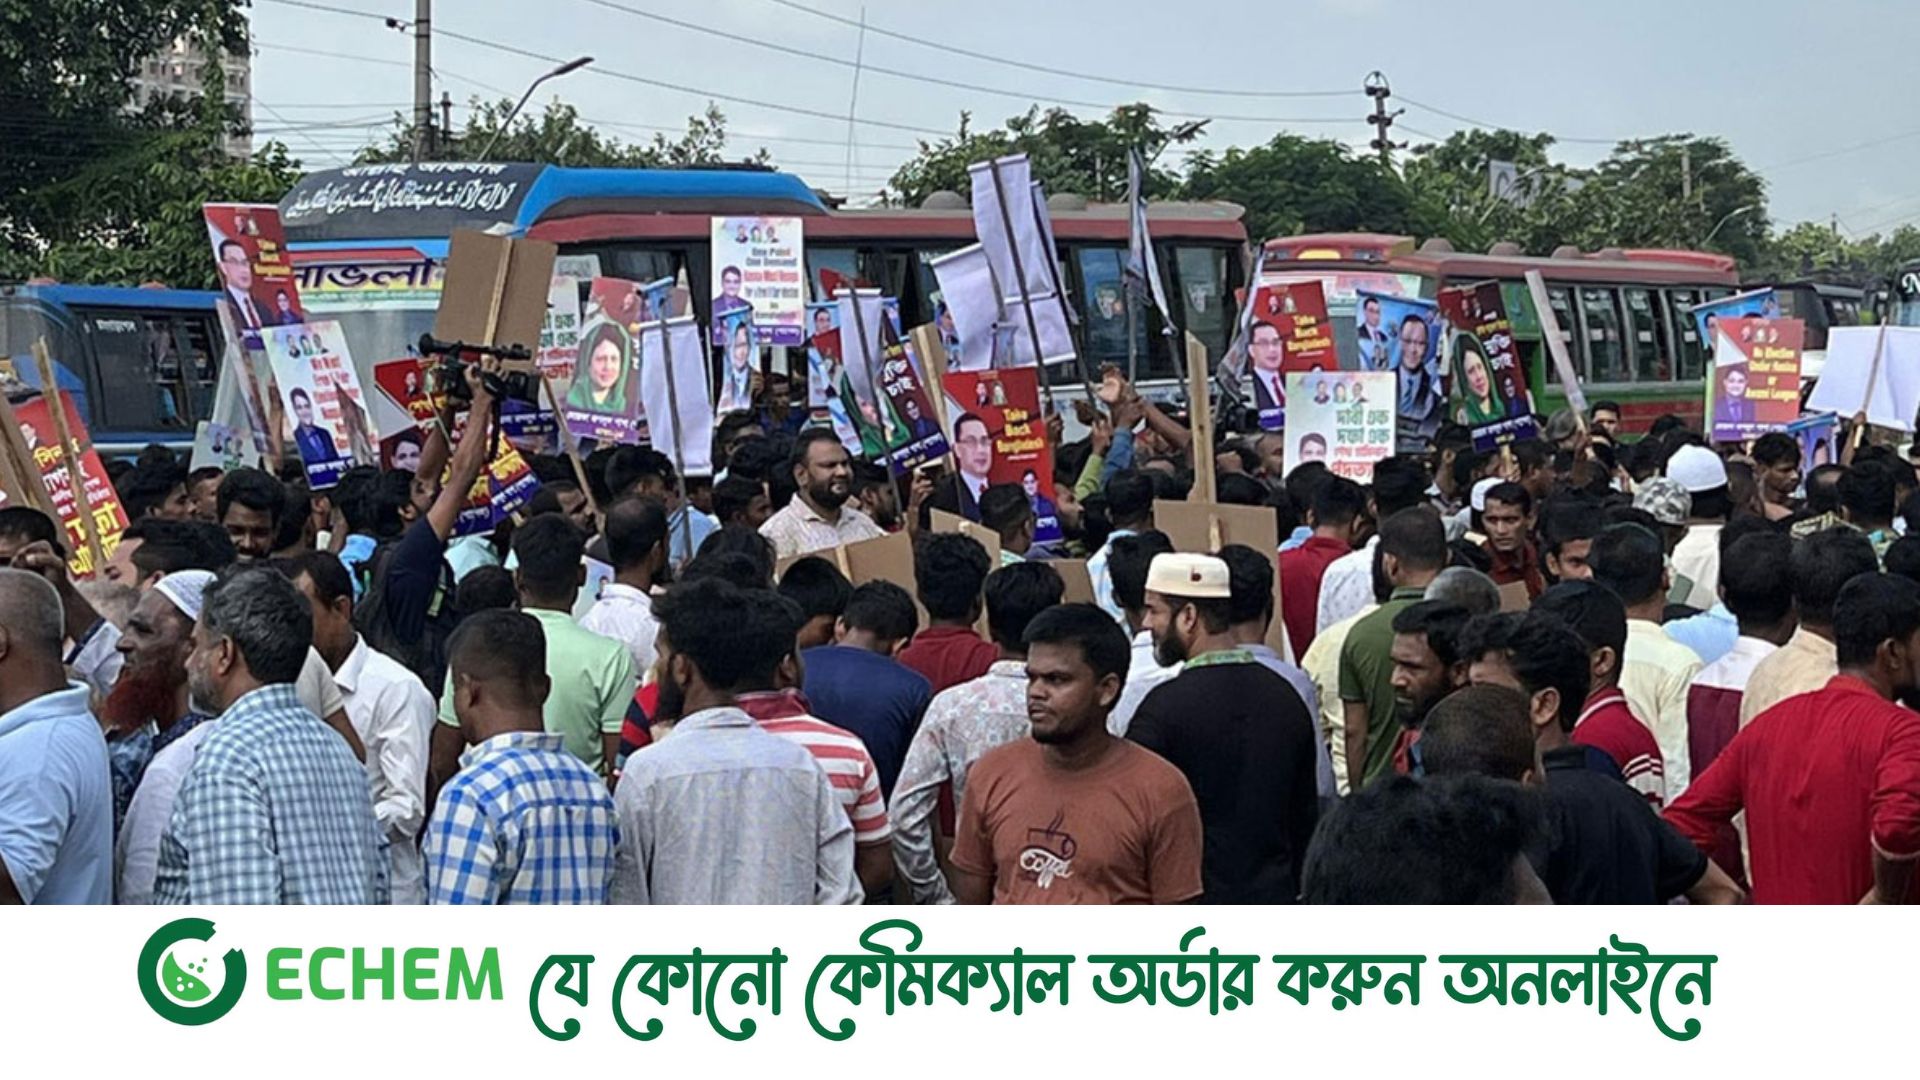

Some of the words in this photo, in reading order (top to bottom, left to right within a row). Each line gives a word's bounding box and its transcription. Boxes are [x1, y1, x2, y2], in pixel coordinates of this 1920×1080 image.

[1003, 409, 1029, 421] Take
[1367, 409, 1390, 425] এক
[1368, 428, 1391, 444] এক
